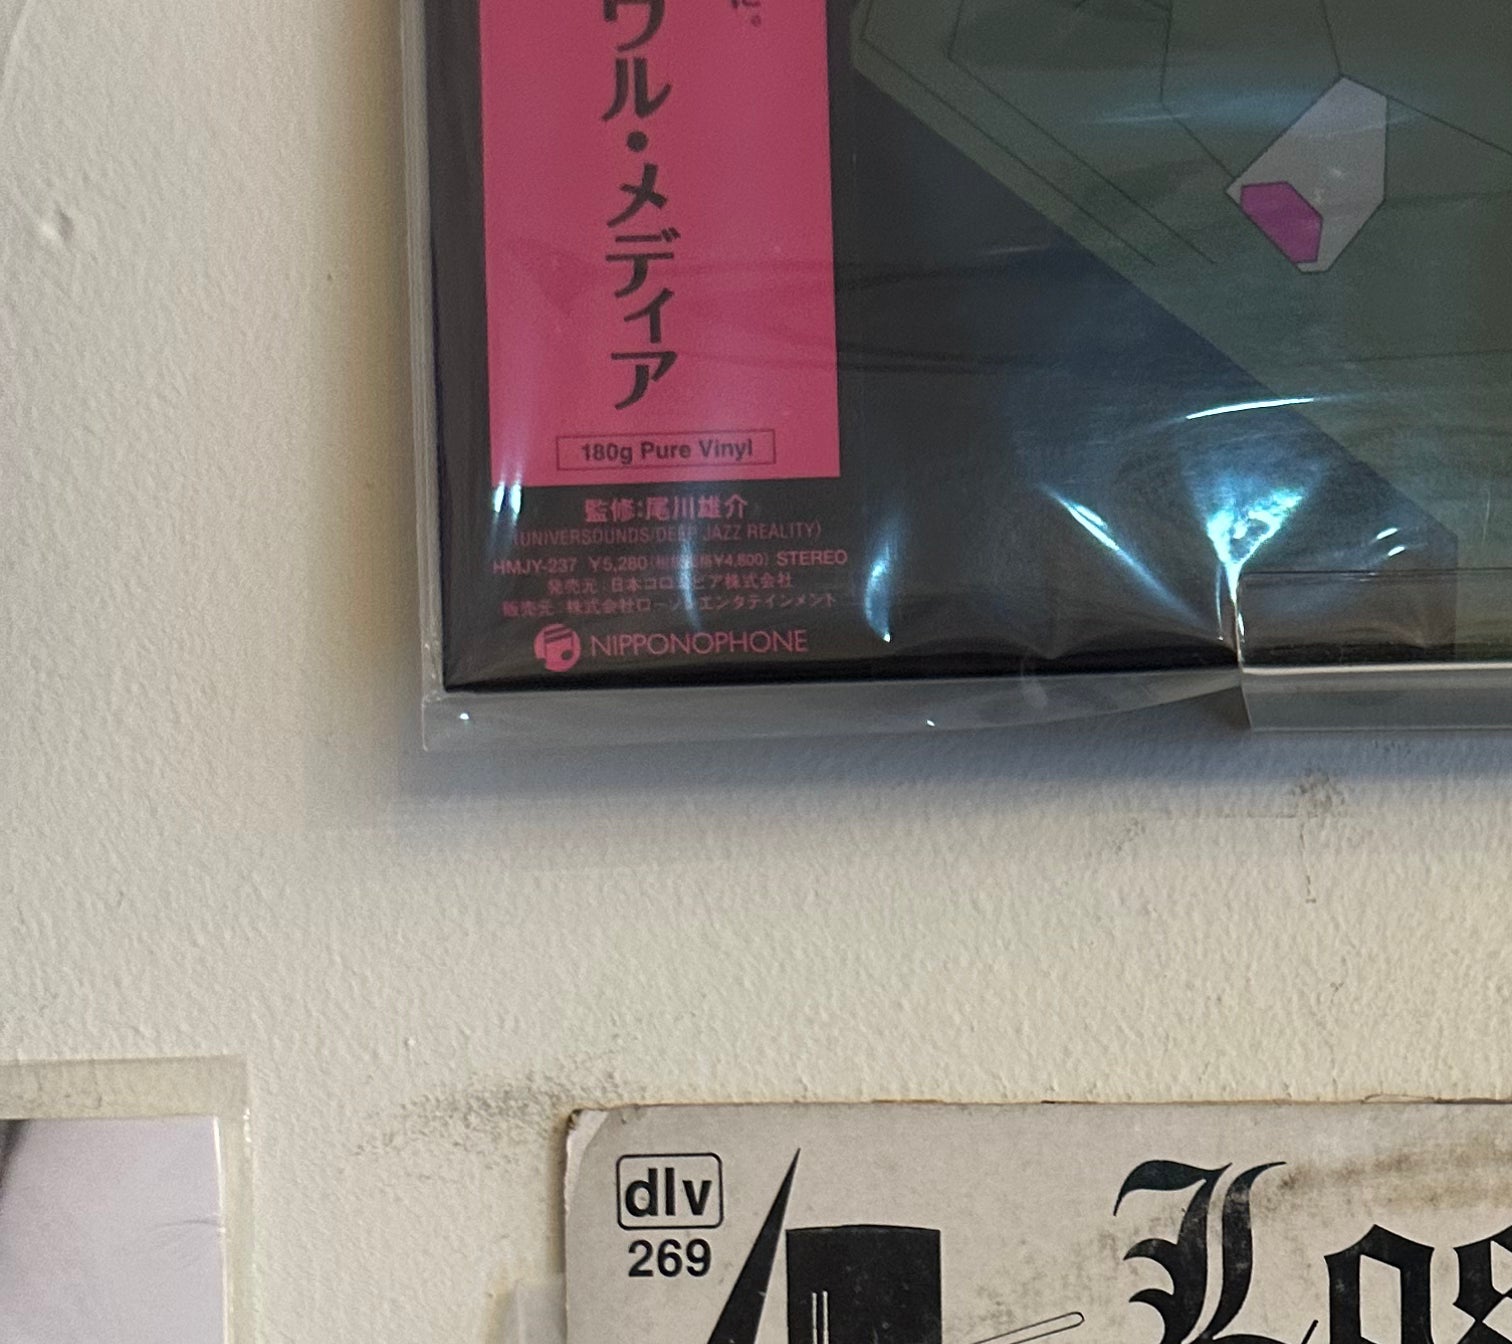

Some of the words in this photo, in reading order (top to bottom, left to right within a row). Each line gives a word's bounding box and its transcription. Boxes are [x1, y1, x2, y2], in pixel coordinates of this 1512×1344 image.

[581, 443, 633, 464] 180g
[640, 440, 691, 459] Pure
[699, 438, 753, 461] Vinyl
[703, 524, 741, 541] JAZZ
[747, 521, 822, 541] REALITY)
[493, 557, 577, 576] HMJY-237
[776, 550, 847, 566] STEREO
[591, 630, 808, 656] NIPPONOPHONE
[625, 1167, 712, 1217] dlv
[628, 1239, 711, 1277] 269
